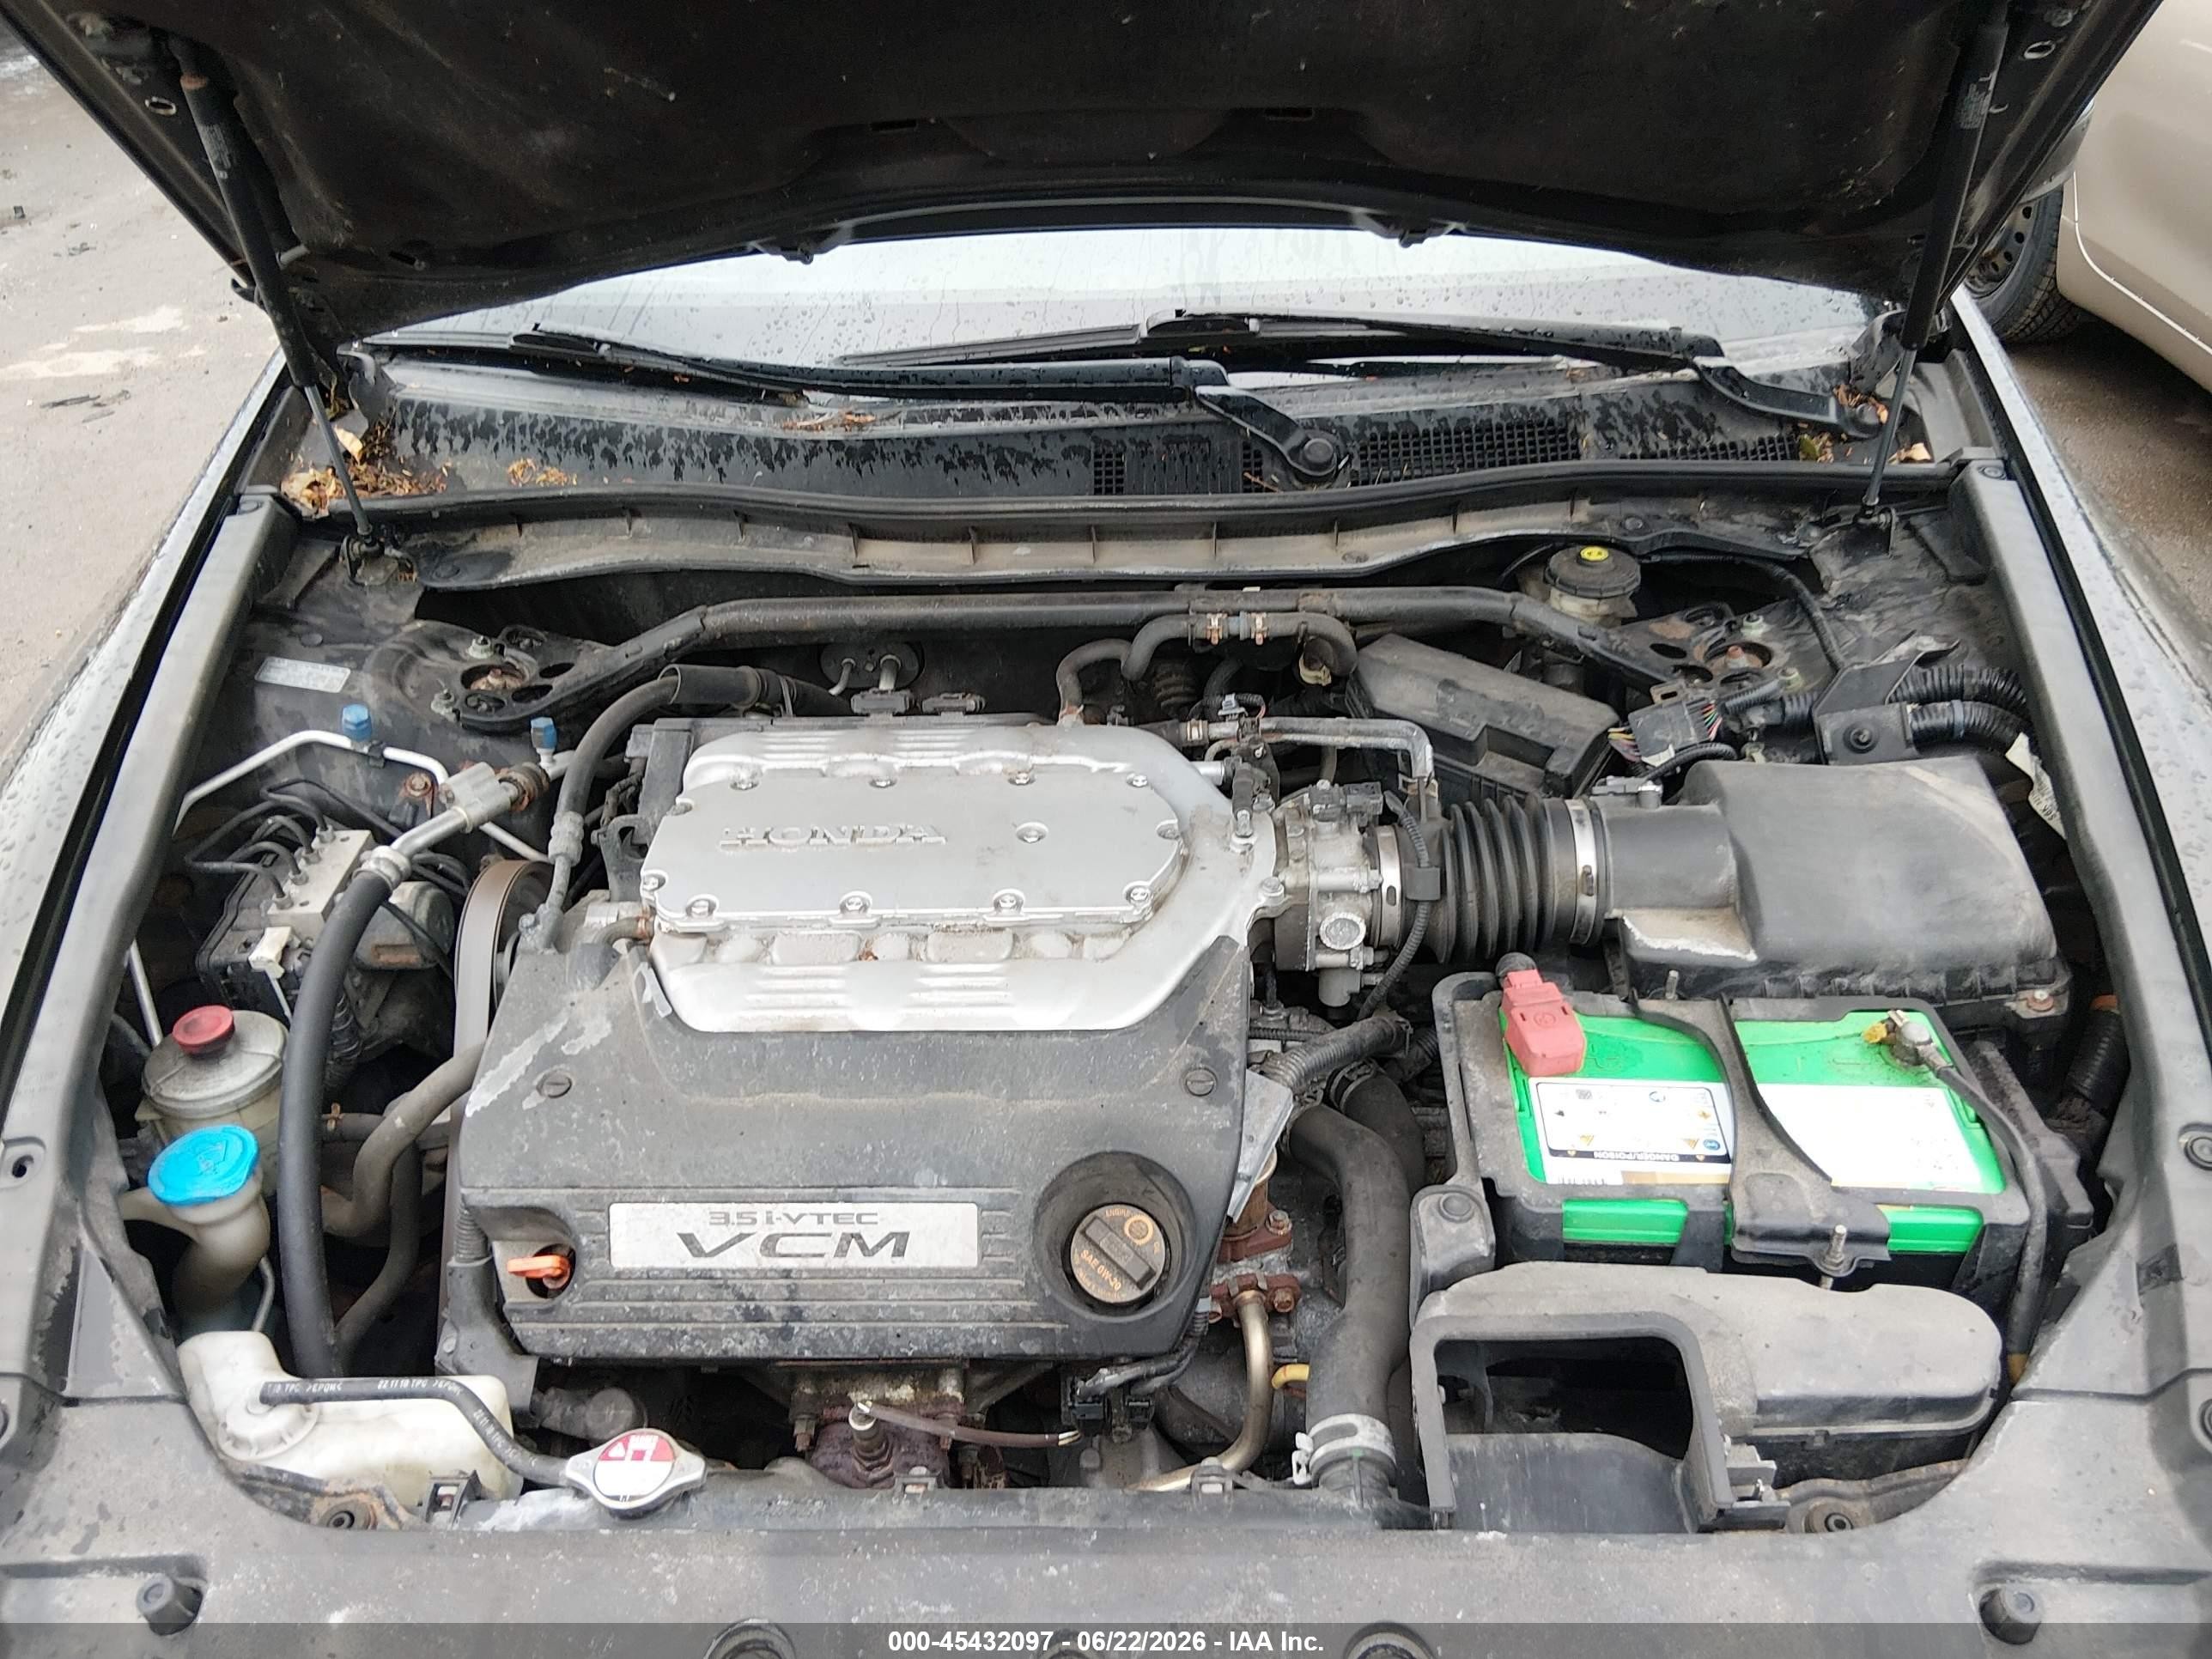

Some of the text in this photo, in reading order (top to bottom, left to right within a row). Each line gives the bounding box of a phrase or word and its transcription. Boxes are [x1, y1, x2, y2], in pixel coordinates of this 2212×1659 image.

[719, 823, 949, 848] HONDA
[708, 1211, 757, 1226] 3.5
[676, 1231, 911, 1259] VCM
[1080, 1249, 1099, 1269] SAE
